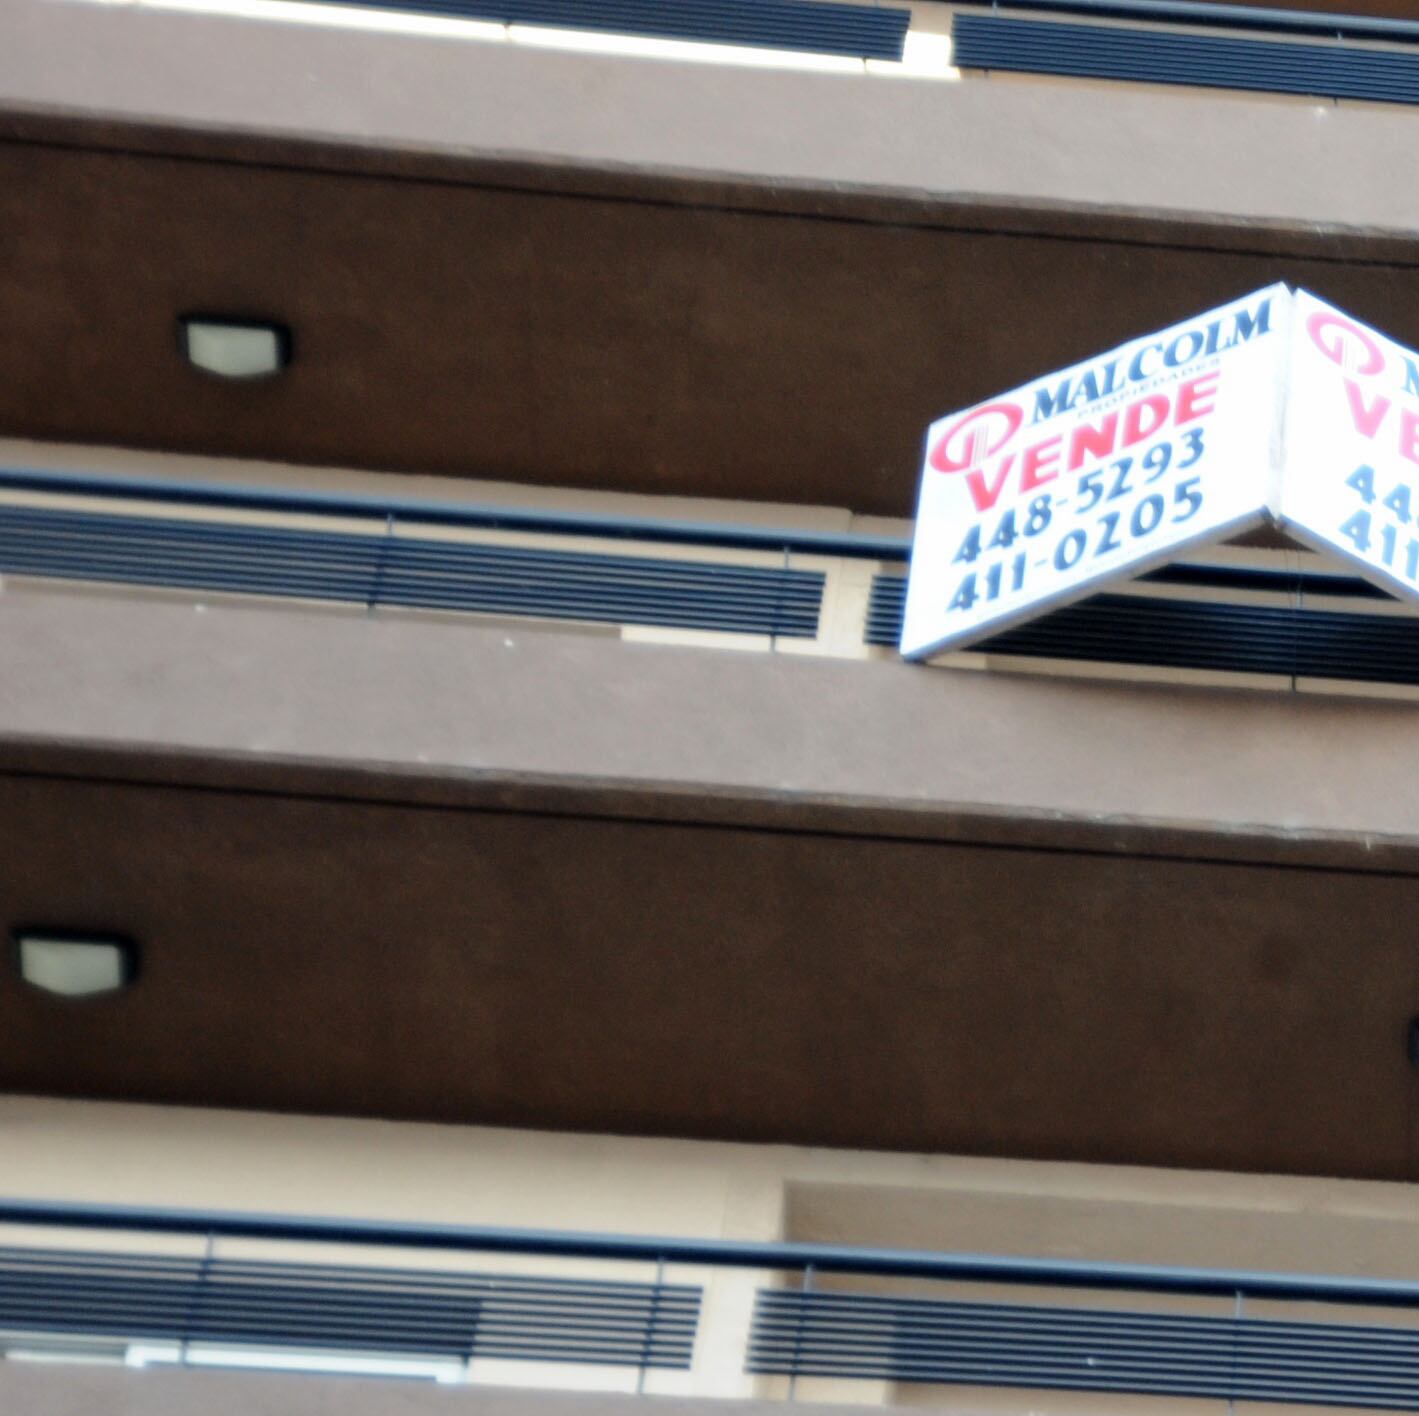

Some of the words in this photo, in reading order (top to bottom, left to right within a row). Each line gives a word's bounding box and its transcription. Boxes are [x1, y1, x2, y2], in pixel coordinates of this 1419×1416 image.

[1028, 299, 1272, 426] MALCOLM
[952, 428, 1205, 566] 448-5293
[965, 370, 1221, 513] VENDE
[946, 476, 1204, 613] 411-0205
